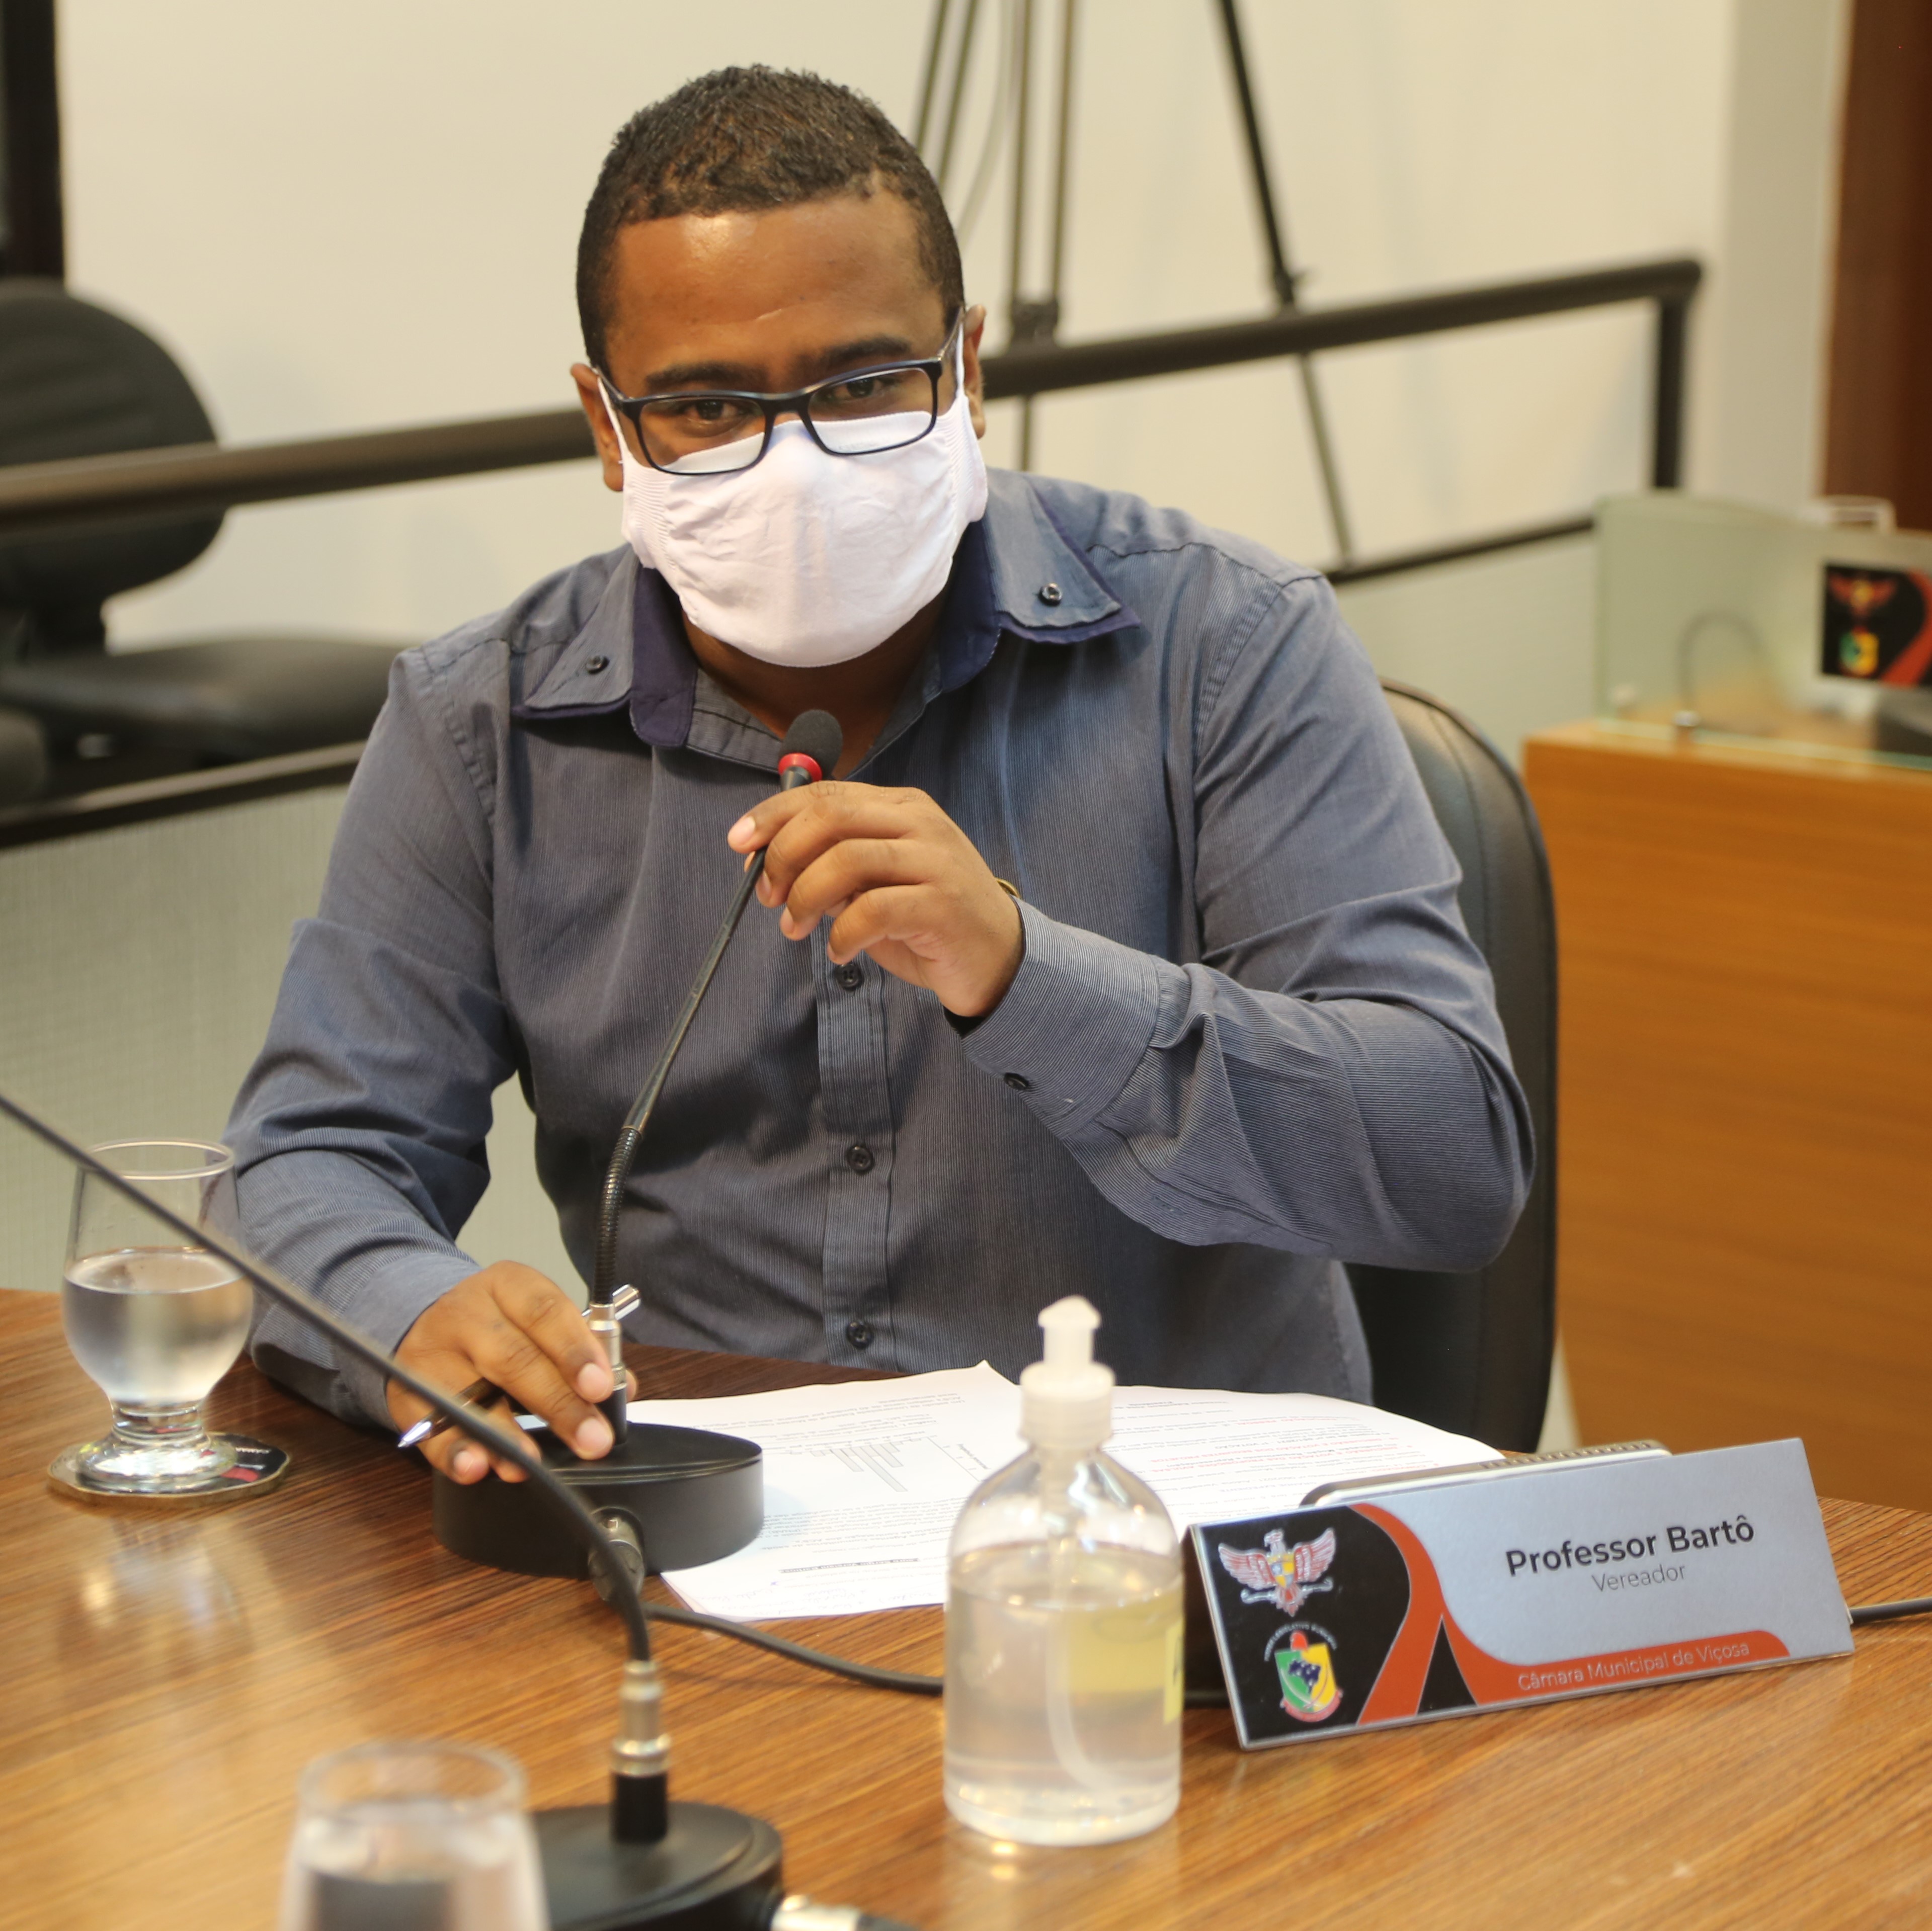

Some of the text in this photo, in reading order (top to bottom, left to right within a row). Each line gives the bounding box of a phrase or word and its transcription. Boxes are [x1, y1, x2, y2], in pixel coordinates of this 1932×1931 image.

[1506, 1515, 1754, 1576] Professor Bartô
[1592, 1564, 1686, 1592] Vereador
[1518, 1642, 1750, 1691] Câmara Municipal de Viçosa
